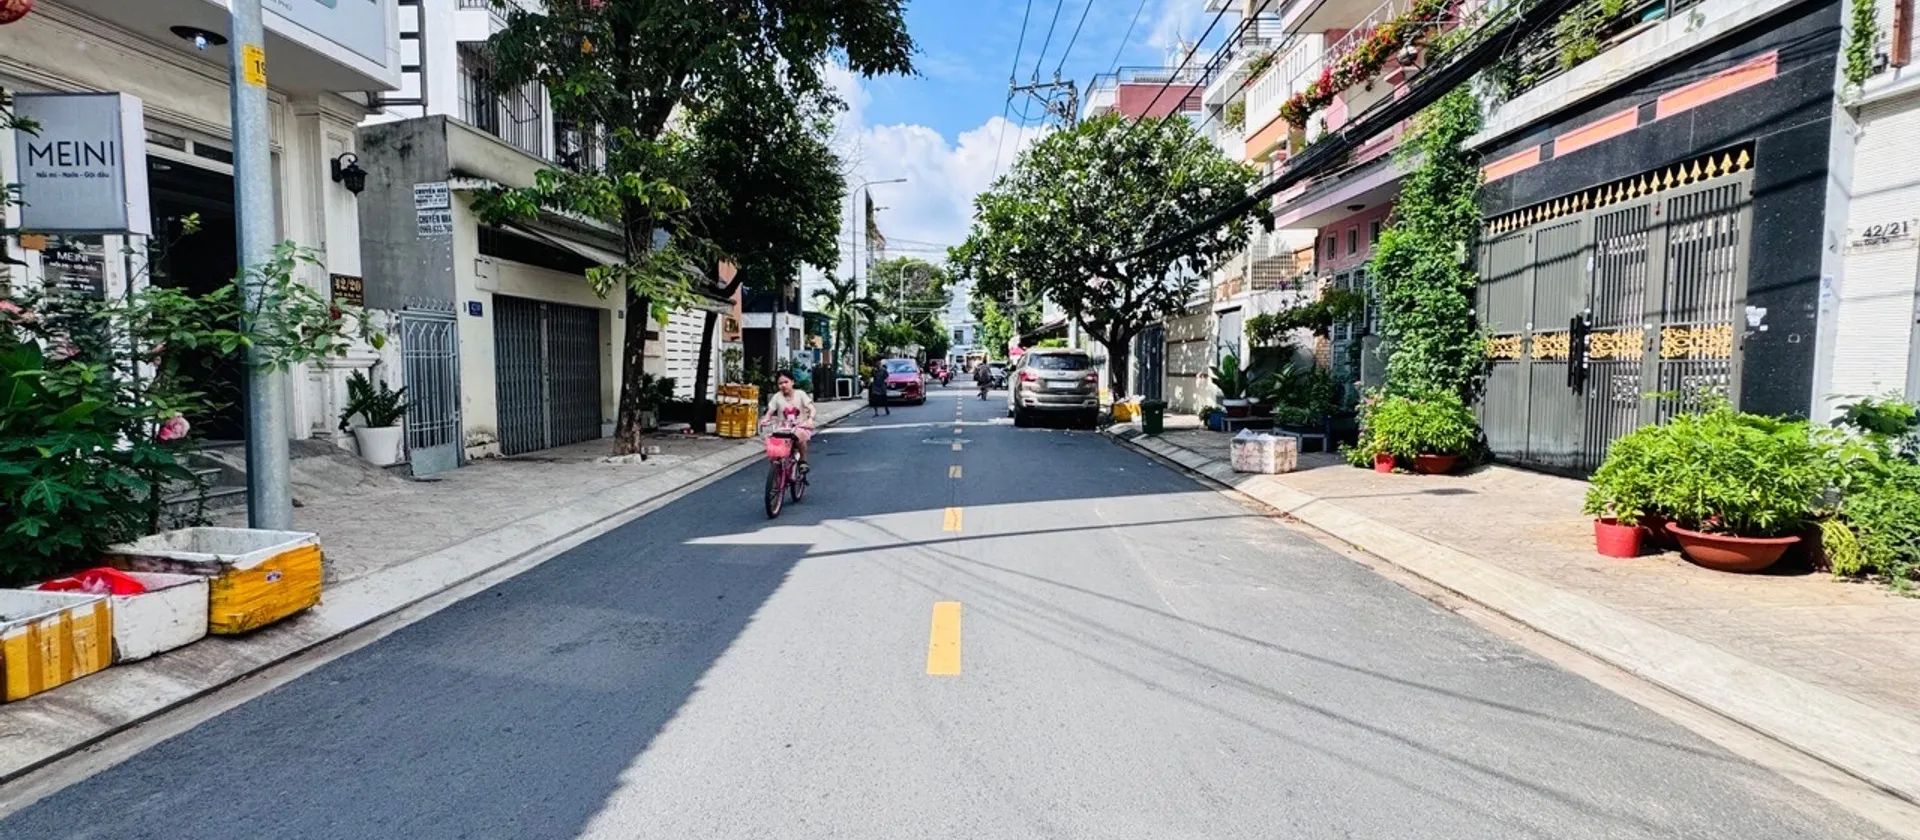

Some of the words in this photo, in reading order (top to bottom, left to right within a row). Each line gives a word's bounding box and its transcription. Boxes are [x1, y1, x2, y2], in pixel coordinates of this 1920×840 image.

[28, 140, 115, 166] MEINI
[1862, 221, 1908, 236] 42/21
[57, 251, 89, 262] MEINI
